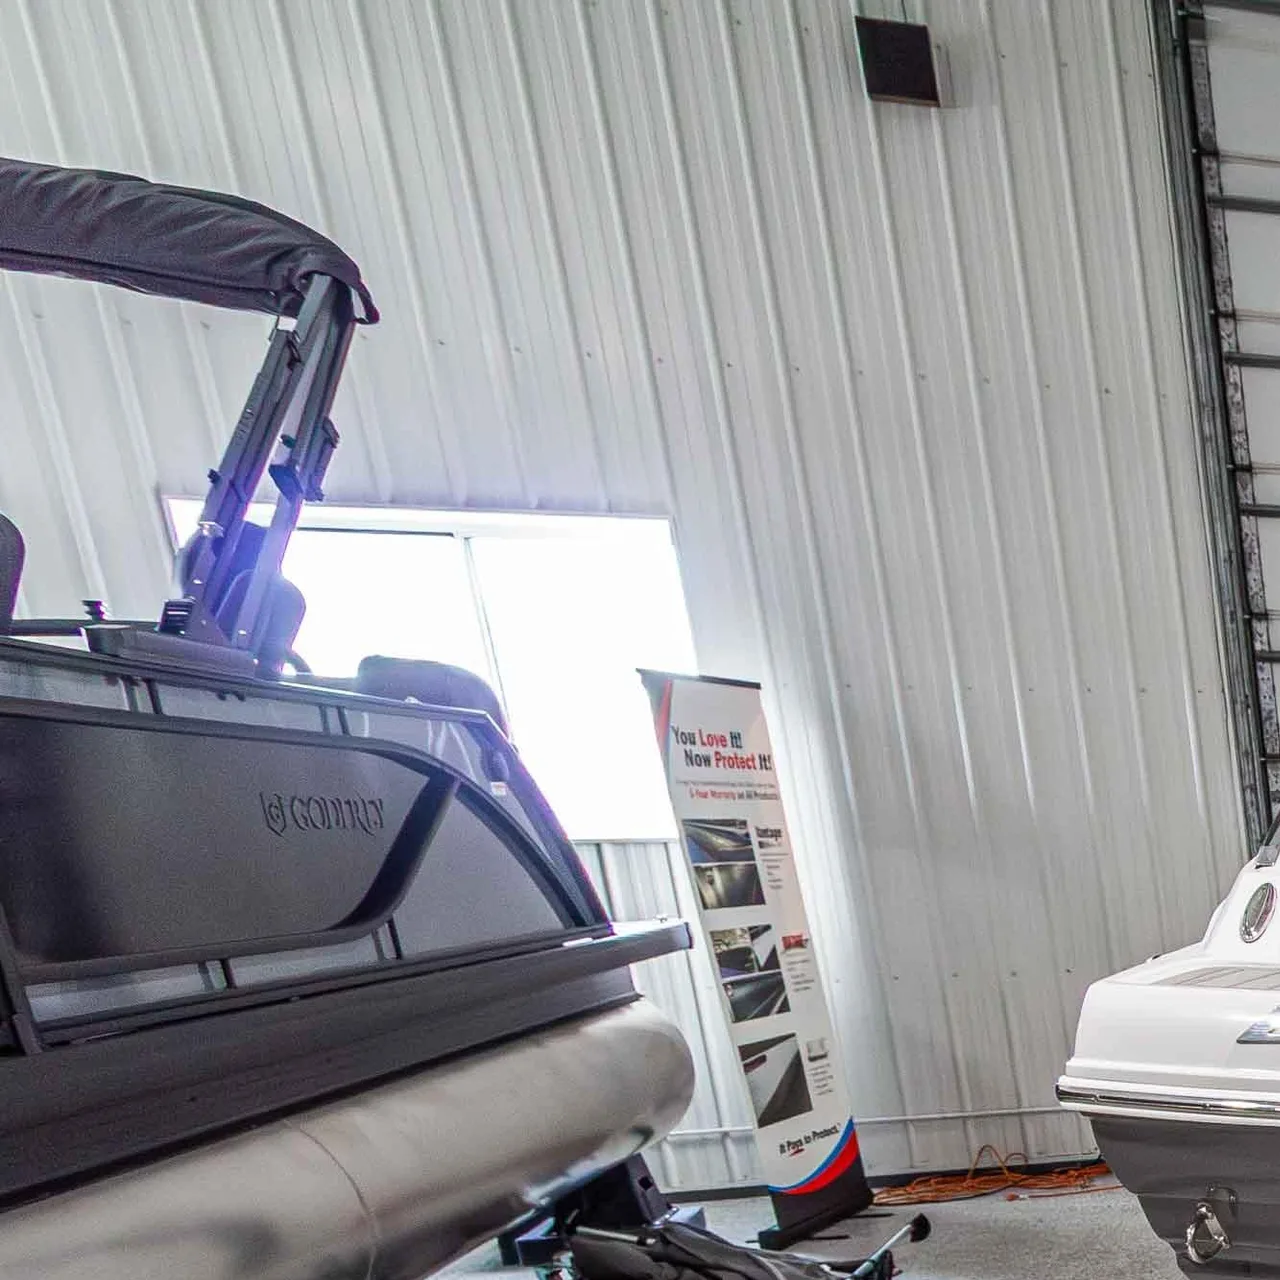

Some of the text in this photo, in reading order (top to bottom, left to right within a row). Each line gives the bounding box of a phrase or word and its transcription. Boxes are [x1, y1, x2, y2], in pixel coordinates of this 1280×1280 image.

[671, 724, 744, 750] You Love It!
[684, 749, 773, 771] Now Protect It!
